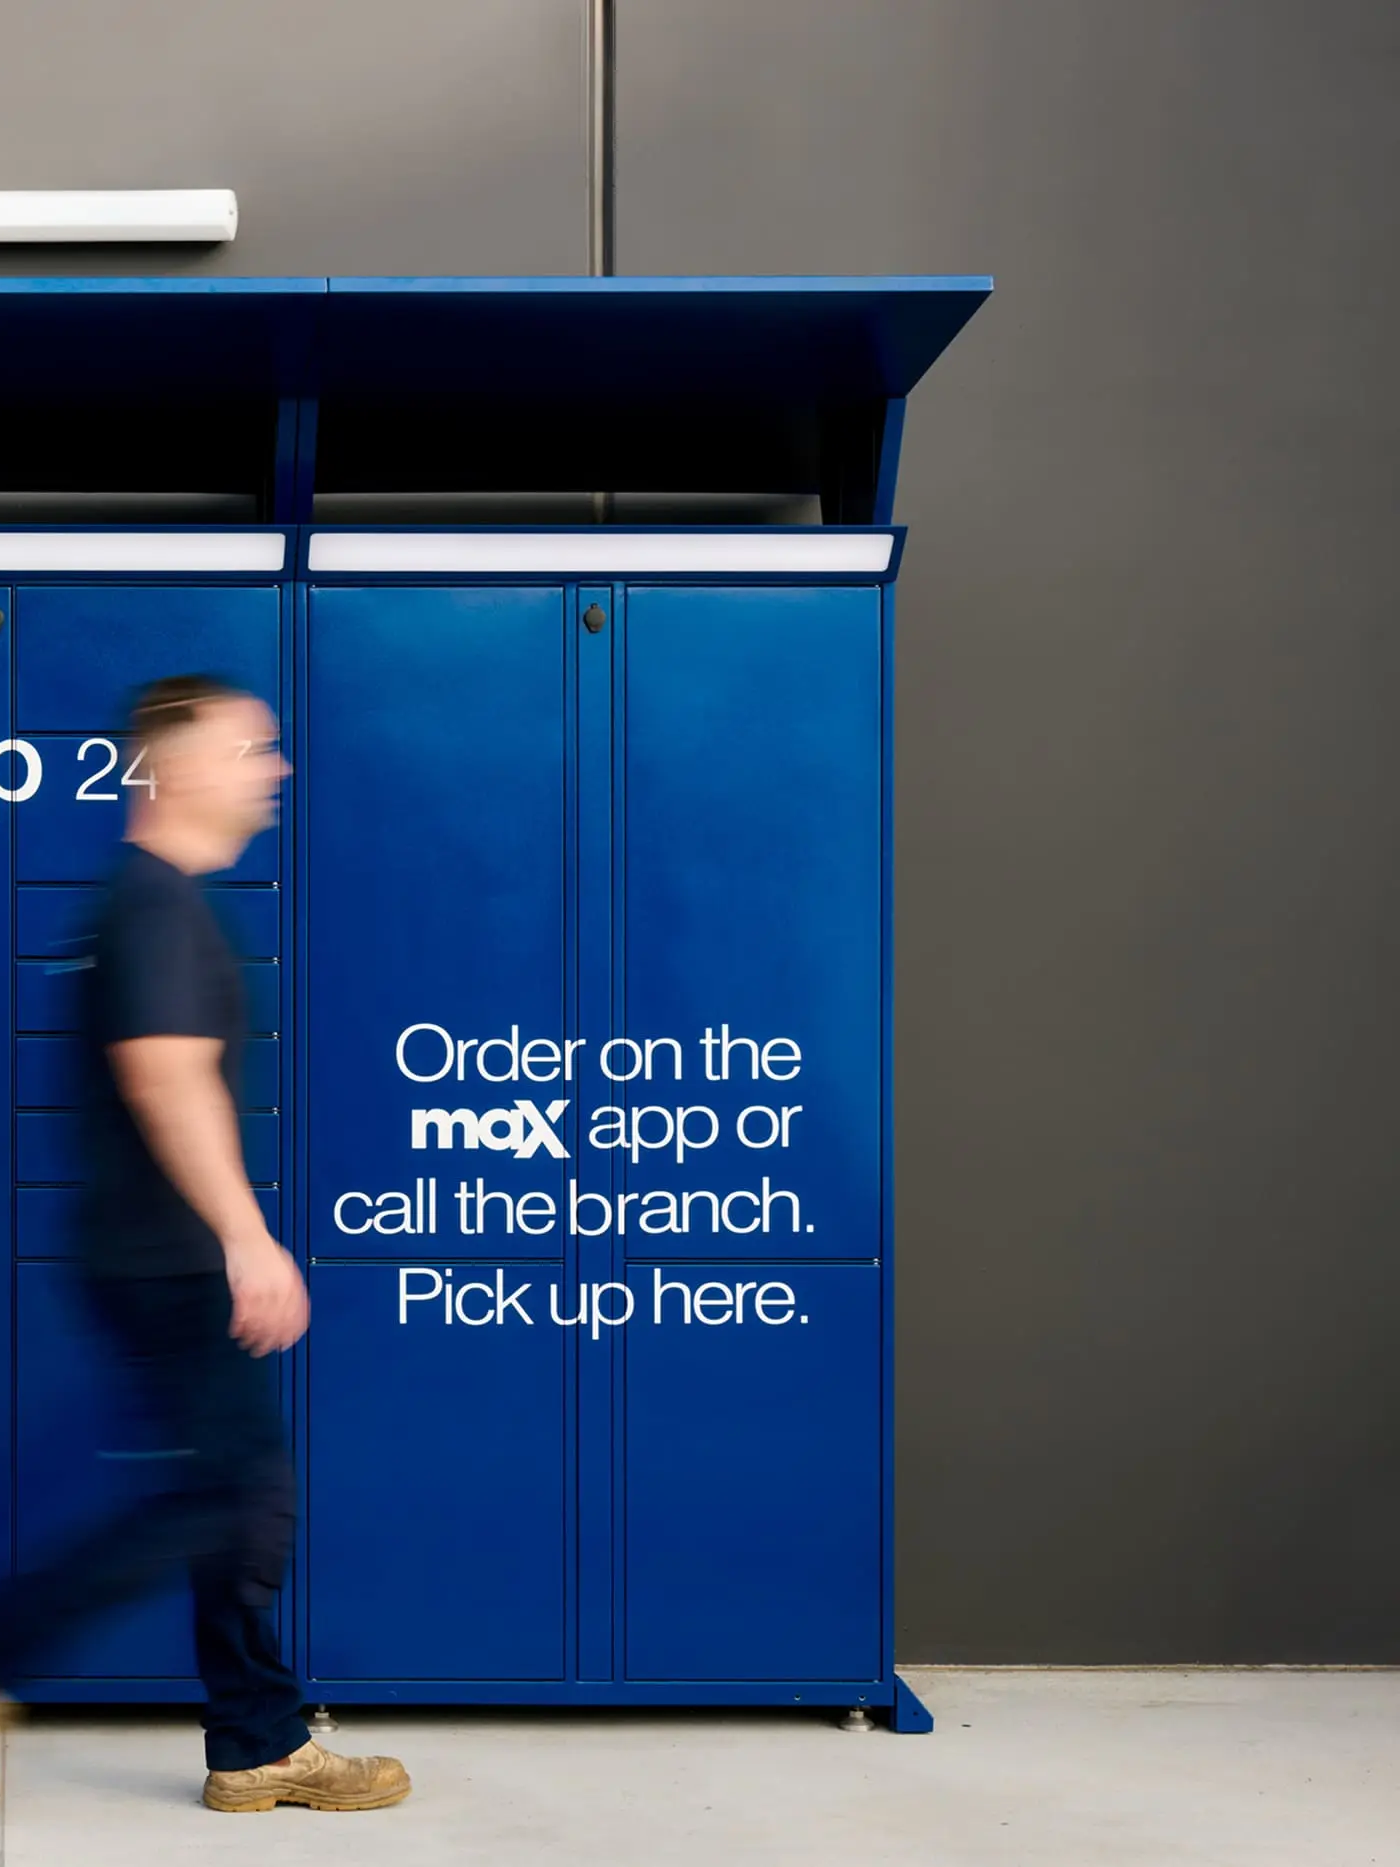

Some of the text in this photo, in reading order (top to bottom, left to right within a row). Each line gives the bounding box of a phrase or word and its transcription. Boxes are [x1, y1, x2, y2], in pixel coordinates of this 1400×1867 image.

[395, 1023, 802, 1083] Order on the
[588, 1105, 720, 1164] app
[736, 1105, 803, 1149] or
[333, 1176, 815, 1237] call the branch.
[399, 1267, 809, 1341] Pick up here.
